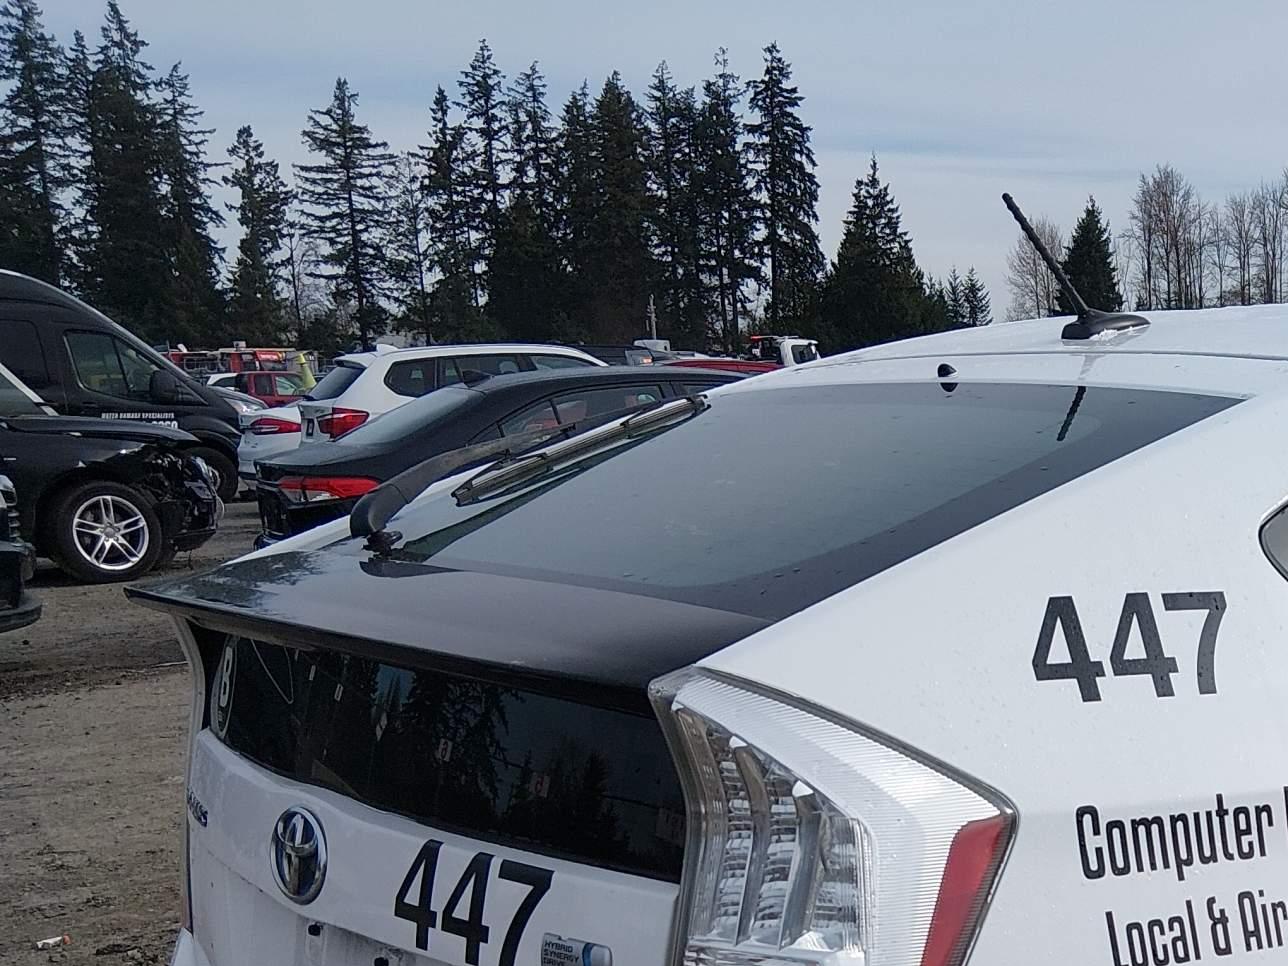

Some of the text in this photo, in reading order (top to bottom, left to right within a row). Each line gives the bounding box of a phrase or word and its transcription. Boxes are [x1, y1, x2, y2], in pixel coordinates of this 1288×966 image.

[1031, 591, 1227, 702] 447
[1076, 792, 1274, 881] Computer
[543, 948, 580, 963] SYNERGY
[544, 940, 574, 953] HYBRID
[1206, 896, 1233, 956] &
